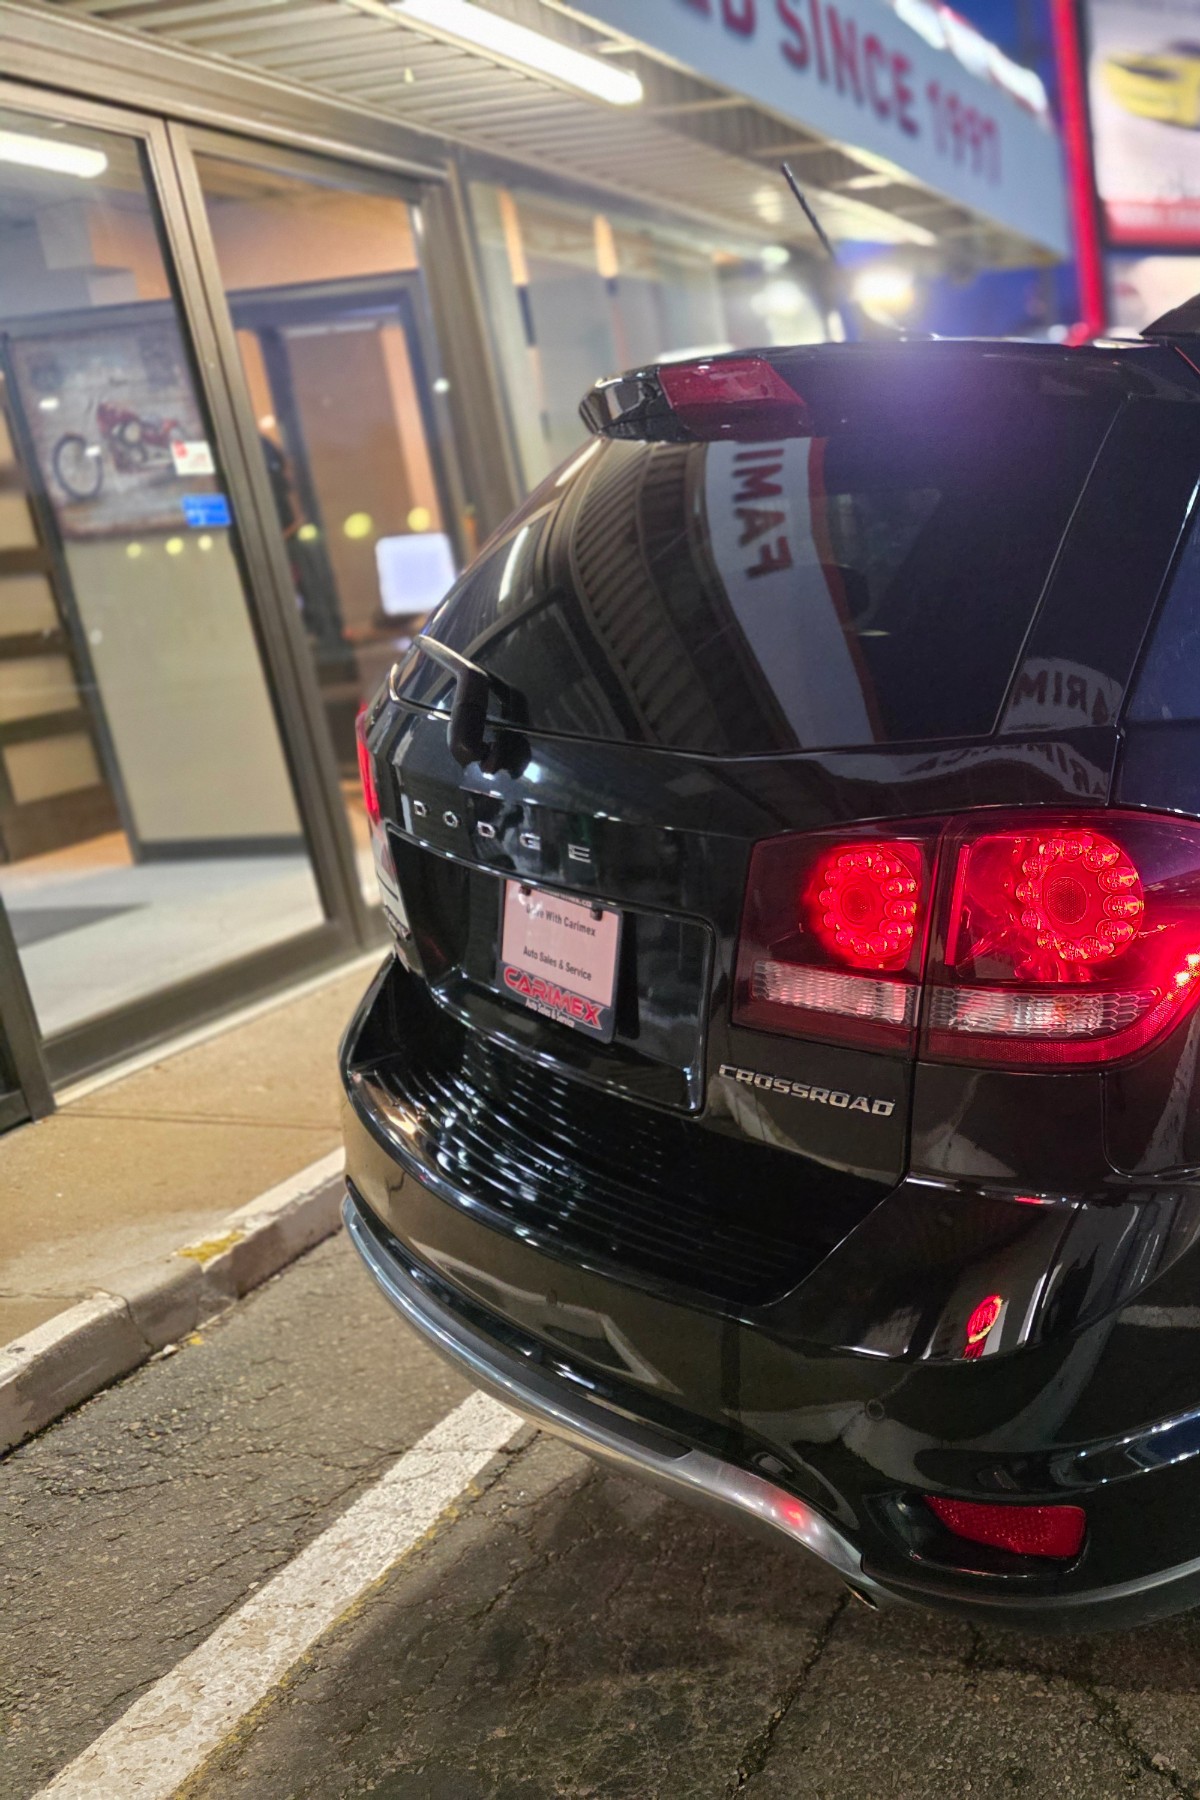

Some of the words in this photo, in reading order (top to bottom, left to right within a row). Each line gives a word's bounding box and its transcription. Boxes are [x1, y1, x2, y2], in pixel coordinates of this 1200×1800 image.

[776, 0, 920, 138] SINCE
[413, 800, 592, 864] DODGE
[545, 909, 563, 924] With
[563, 916, 596, 937] Carimex
[523, 945, 538, 961] Auto
[539, 951, 557, 968] Sales
[558, 958, 564, 970] &
[565, 962, 592, 982] Service
[503, 965, 603, 1030] CARIMEX
[719, 1064, 896, 1117] CROSSROAD
